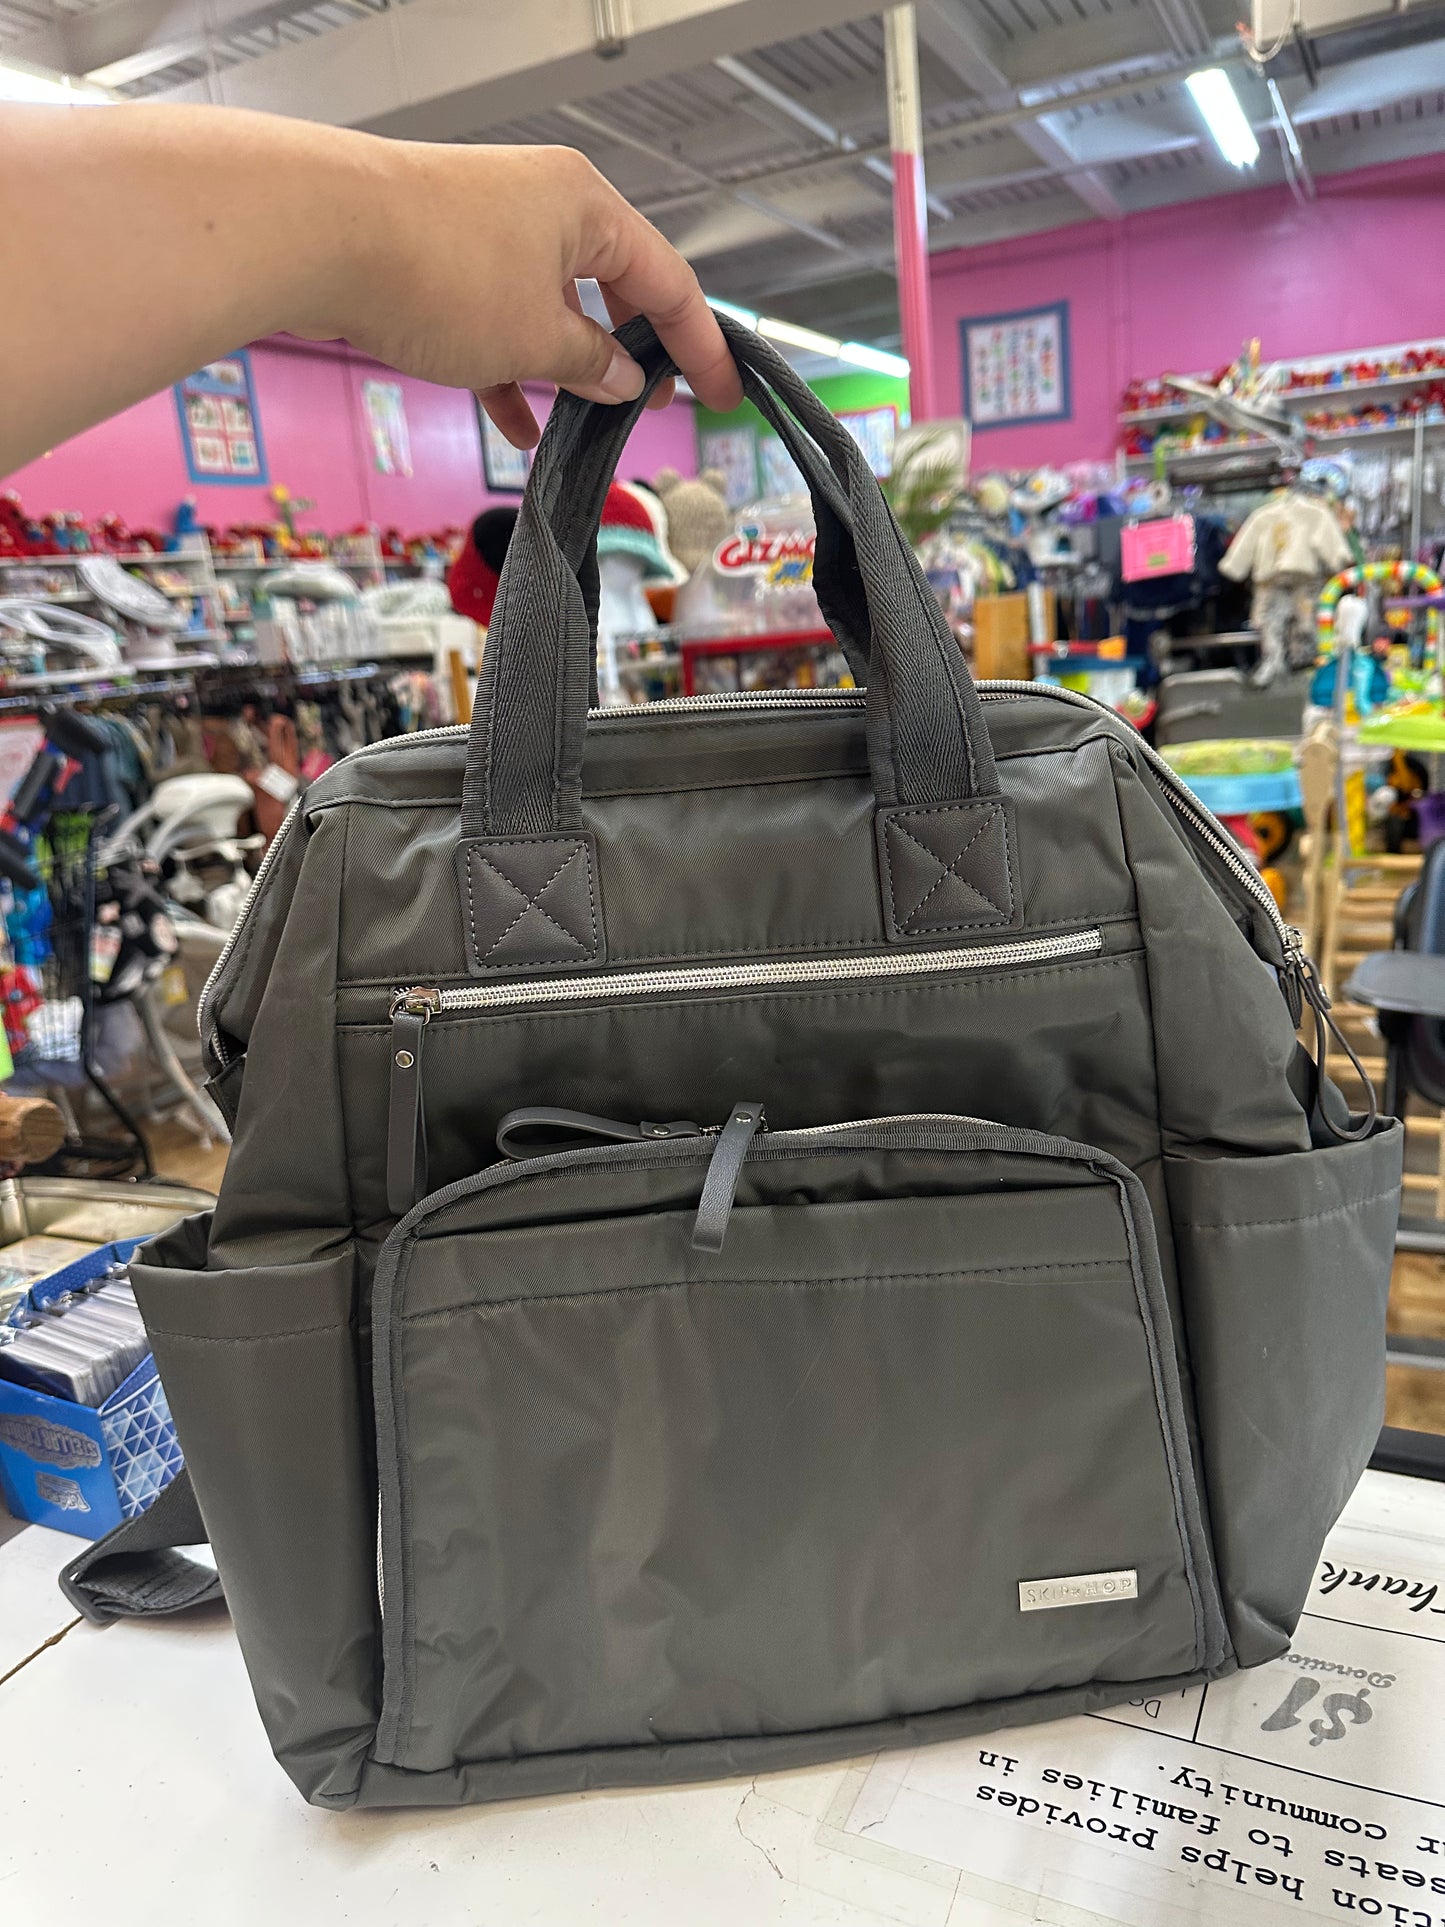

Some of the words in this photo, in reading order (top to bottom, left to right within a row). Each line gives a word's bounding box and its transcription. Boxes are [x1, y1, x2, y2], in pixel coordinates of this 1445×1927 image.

[1085, 1578, 1132, 1597] HOP
[1260, 1676, 1373, 1747] $1
[978, 1750, 1020, 1777] in
[976, 1785, 1159, 1851] provides
[1041, 1768, 1221, 1835] families
[1157, 1765, 1388, 1841] community.
[1247, 1828, 1294, 1858] to
[1181, 1845, 1305, 1901] helps
[1324, 1849, 1445, 1895] seats
[1332, 1888, 1445, 1927] tion
